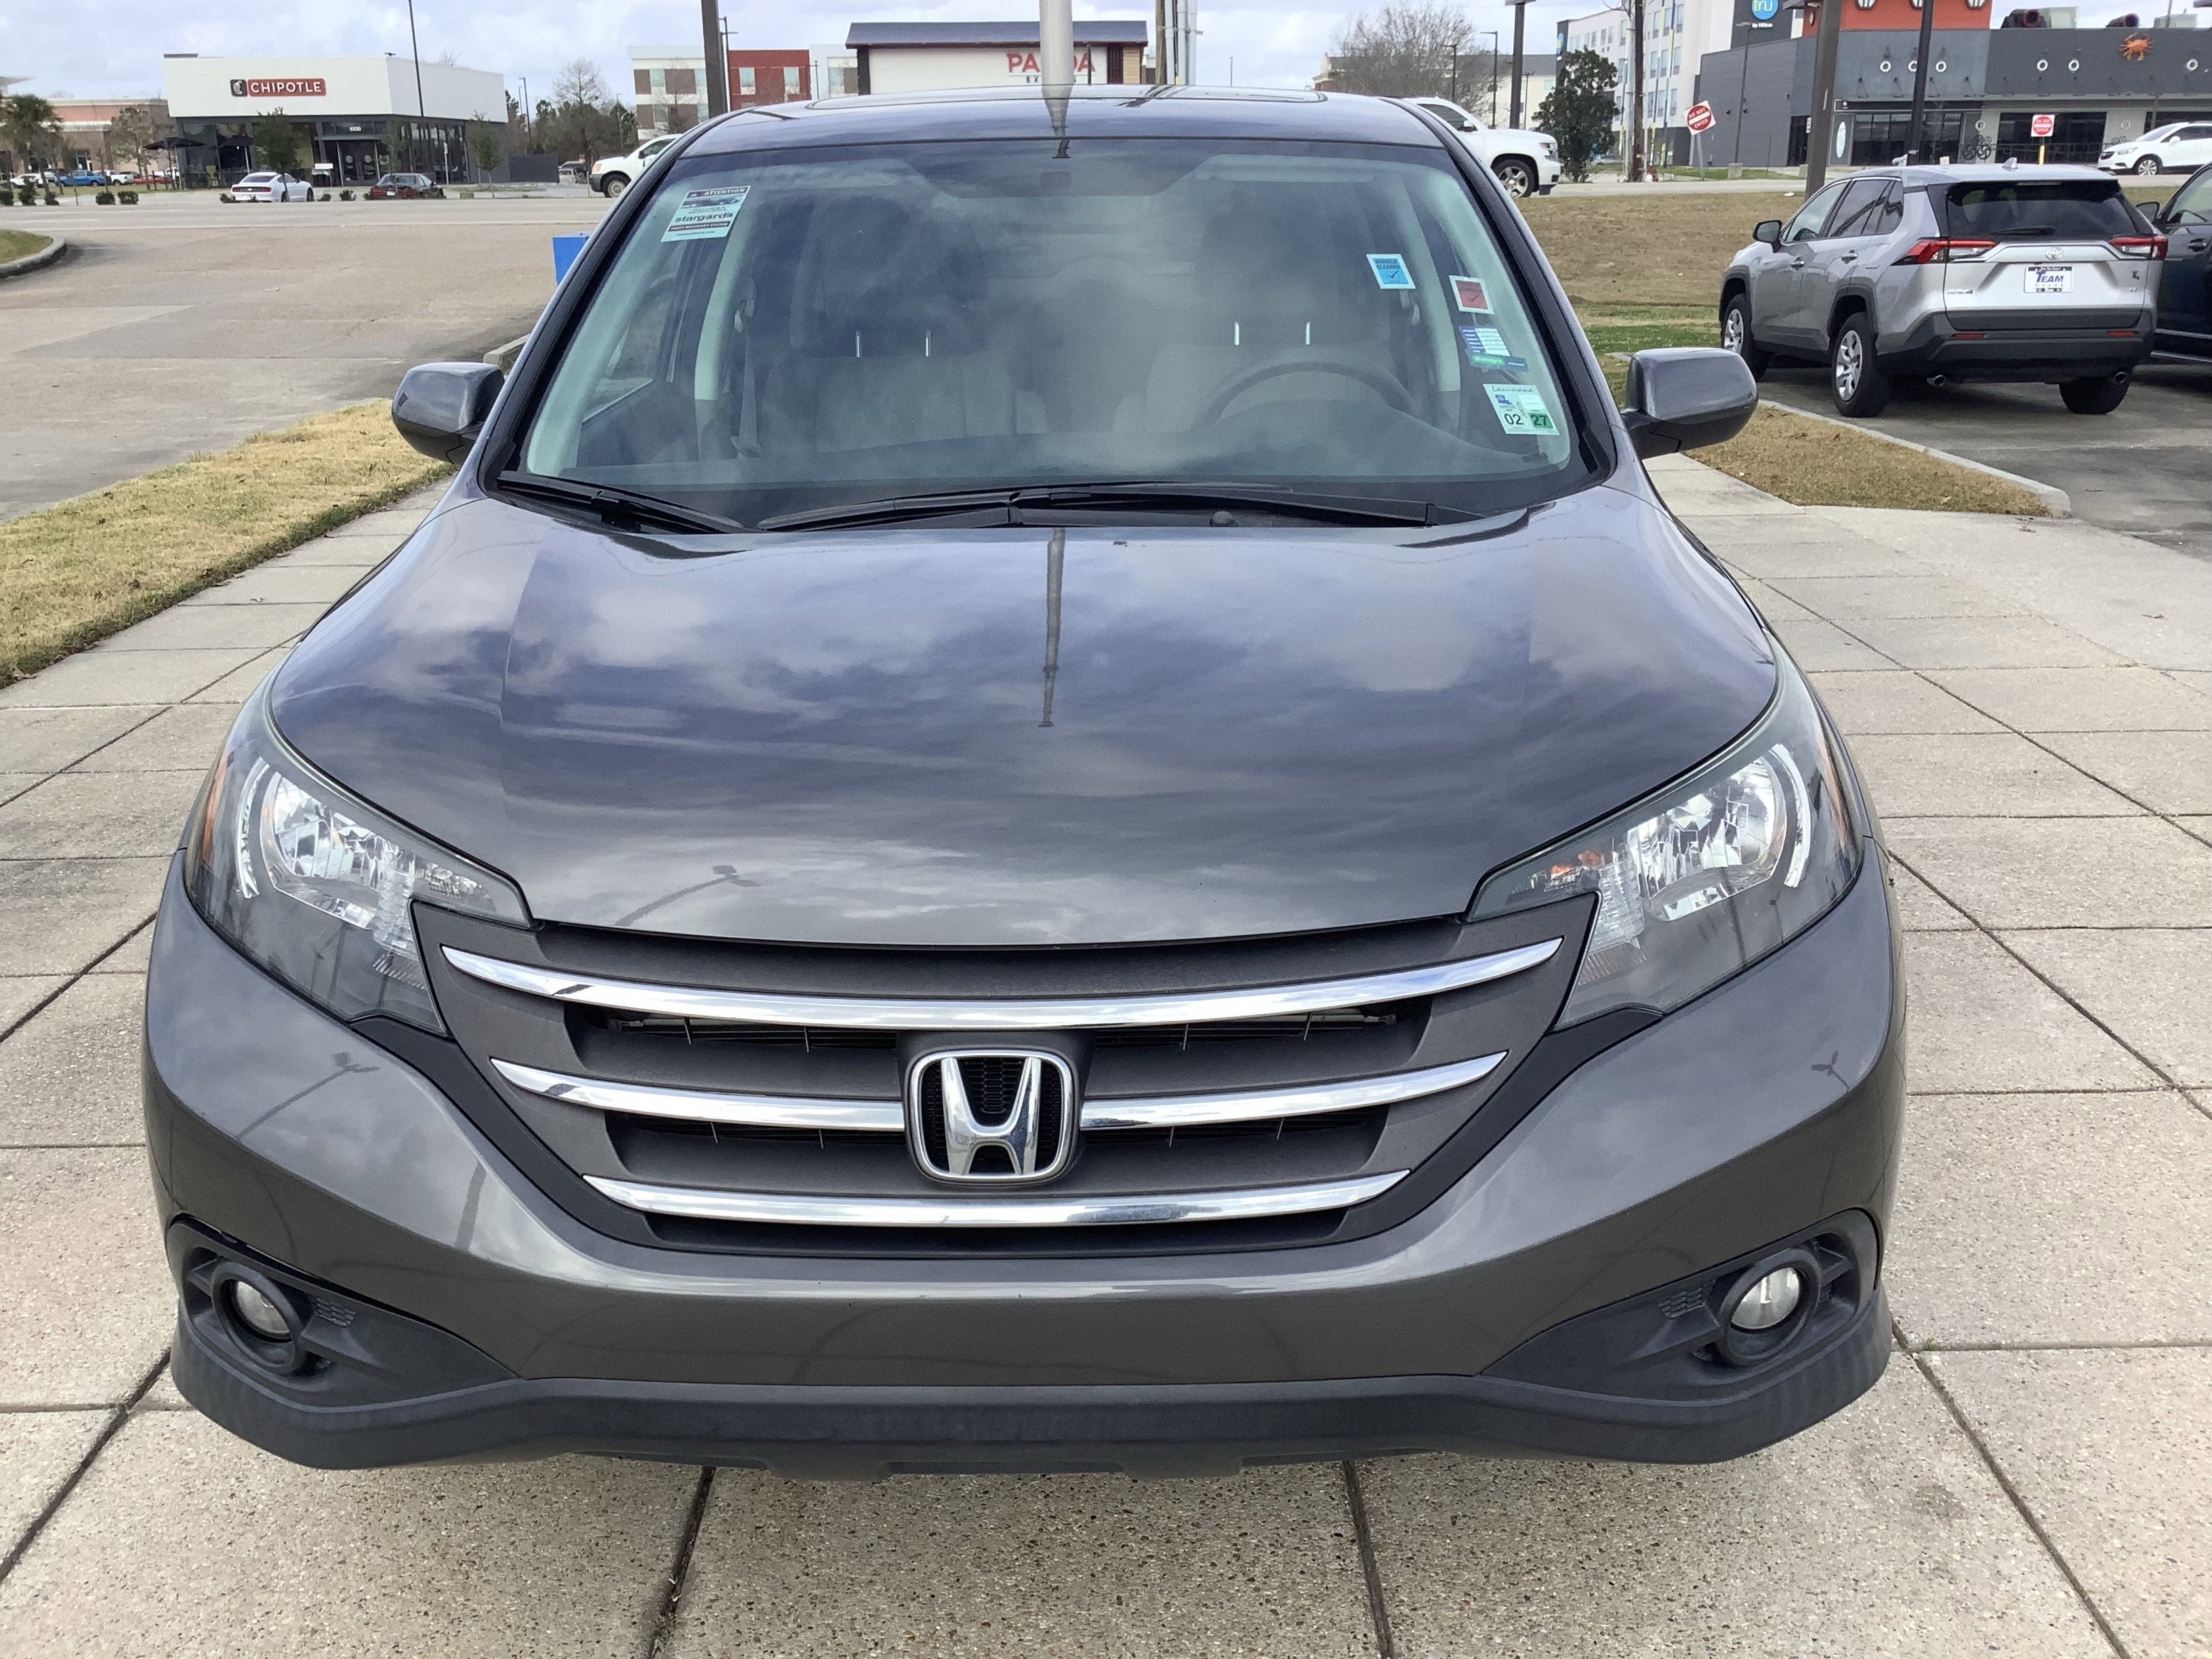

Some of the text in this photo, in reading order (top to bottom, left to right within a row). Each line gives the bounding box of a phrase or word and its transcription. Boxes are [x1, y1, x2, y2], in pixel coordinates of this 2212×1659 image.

[1006, 53, 1096, 73] PAA
[250, 81, 322, 93] CHIPOTLE
[704, 188, 745, 196] ATTENTION
[2036, 269, 2064, 283] TEAM
[1504, 413, 1547, 426] 02 27
